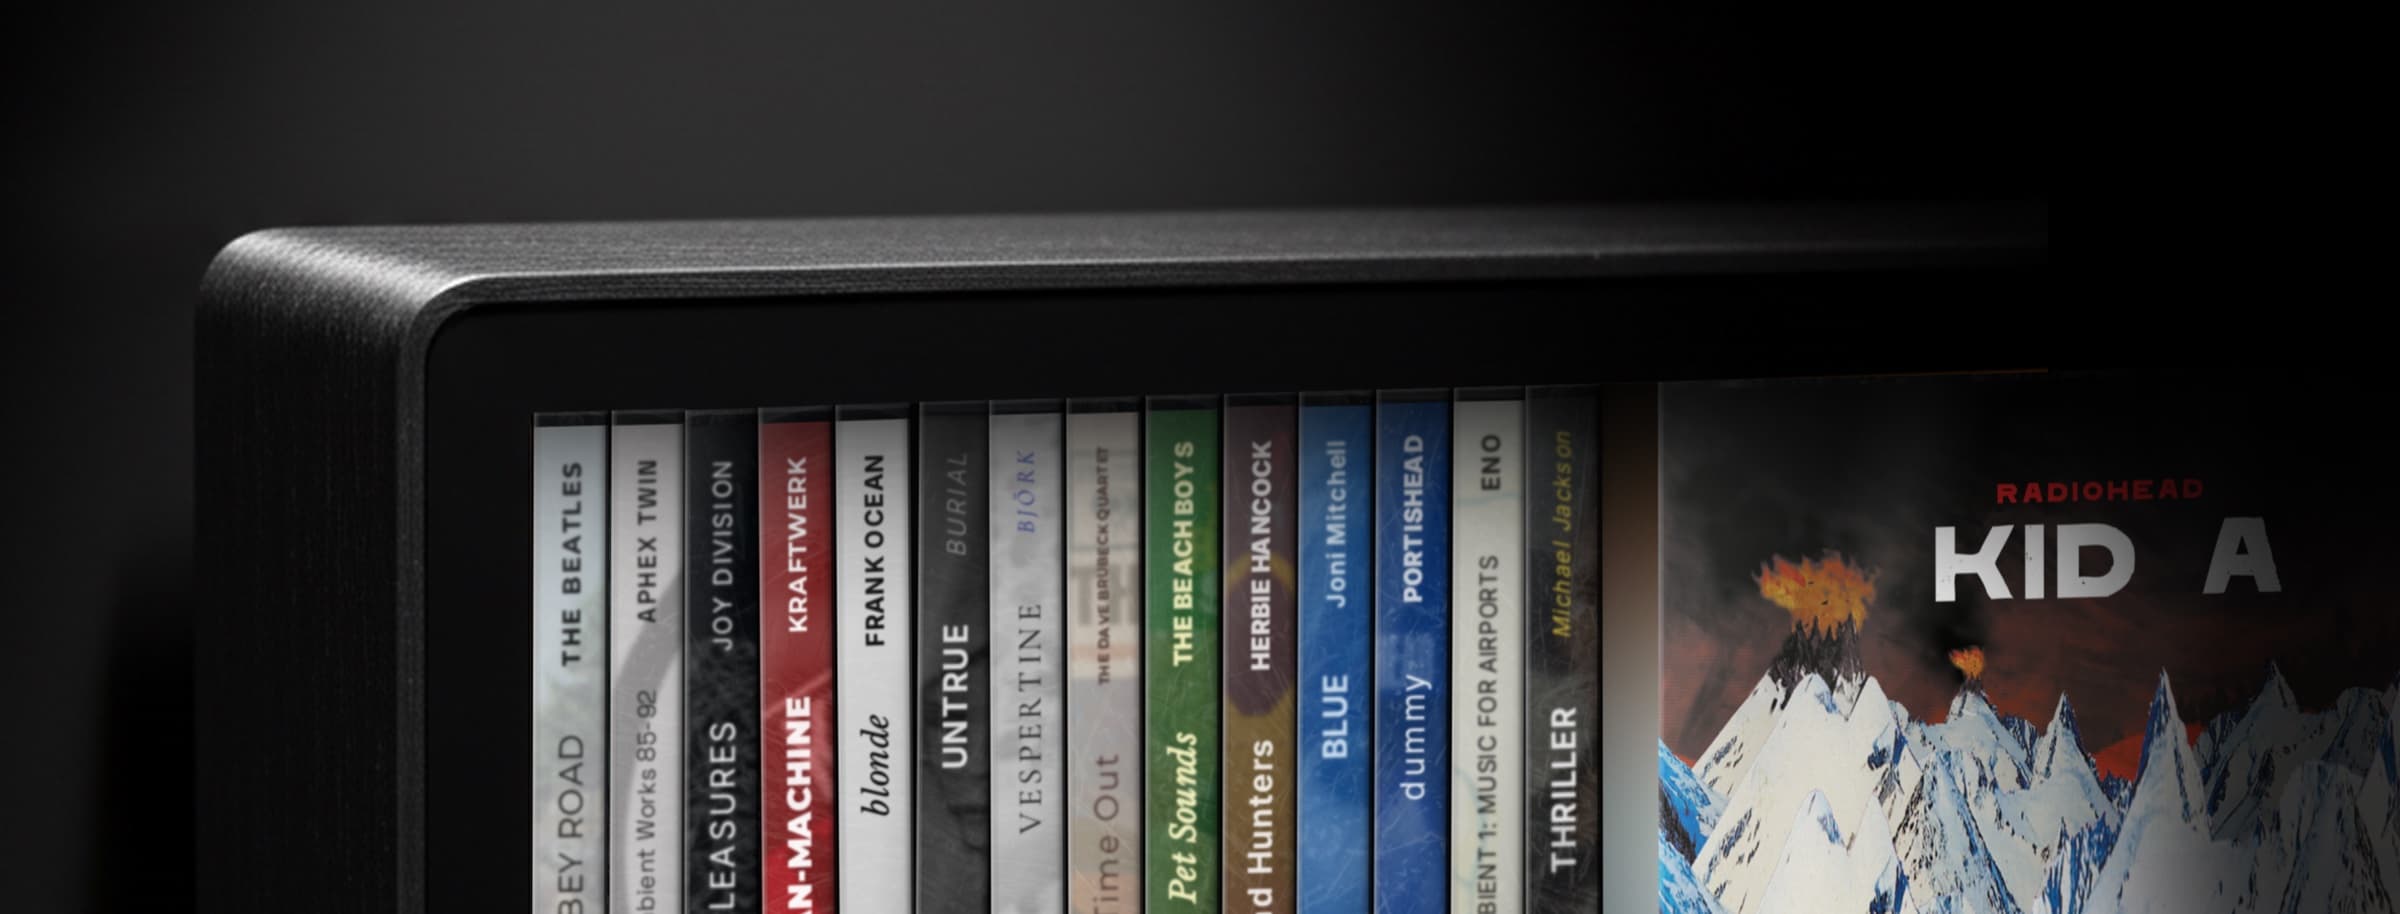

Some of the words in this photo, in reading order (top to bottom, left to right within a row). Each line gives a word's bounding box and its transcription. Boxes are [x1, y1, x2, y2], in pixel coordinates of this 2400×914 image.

[637, 460, 657, 525] TWIN
[864, 455, 884, 548] OCEAN
[947, 453, 967, 555] BURIAL
[1014, 450, 1038, 533] BJÖRK
[1096, 446, 1110, 521] QUARTET
[1174, 442, 1193, 514] BOYS
[1326, 440, 1346, 547] Mitchell
[1481, 434, 1500, 491] ENO
[1552, 430, 1571, 532] Jackson
[1996, 480, 2202, 504] RADIOHEAD
[561, 463, 582, 594] BEATLES
[713, 462, 732, 585] DIVISION
[787, 458, 807, 632] KRAFTWERK
[1251, 441, 1271, 572] HANCOCK
[1403, 435, 1423, 603] PORTISHEAD
[637, 537, 657, 622] APHEX
[864, 556, 884, 646] FRANK
[1097, 523, 1110, 600] BRUBECK
[1174, 520, 1193, 611] BEACH
[1326, 553, 1346, 608] Joni
[1552, 539, 1571, 638] Michael
[1935, 523, 2135, 601] KID
[2203, 517, 2281, 594] A
[561, 610, 582, 666] THE
[713, 599, 732, 651] JOY
[1097, 604, 1110, 649] DAVE
[1172, 627, 1193, 666] THE
[1251, 578, 1271, 670] HERBIE
[1478, 556, 1498, 682] AIRPORTS
[943, 624, 968, 769] UNTRUE
[1098, 655, 1110, 685] THE
[1478, 688, 1497, 728] FOR
[636, 689, 656, 762] 85-92
[1018, 604, 1042, 835] VESPERTINE
[1322, 675, 1347, 759] BLUE
[1400, 675, 1431, 800] dummy
[558, 736, 584, 838] ROAD
[636, 770, 656, 841] Works
[860, 714, 889, 817] blonde
[1094, 754, 1119, 820] Out
[1168, 732, 1197, 842] Sounds
[1248, 740, 1273, 874] Hunters
[1478, 740, 1497, 819] MUSIC
[1551, 707, 1576, 873] THRILLER
[709, 722, 736, 909] LEASURES
[1478, 823, 1497, 838] 1:
[1168, 850, 1197, 905] Pet
